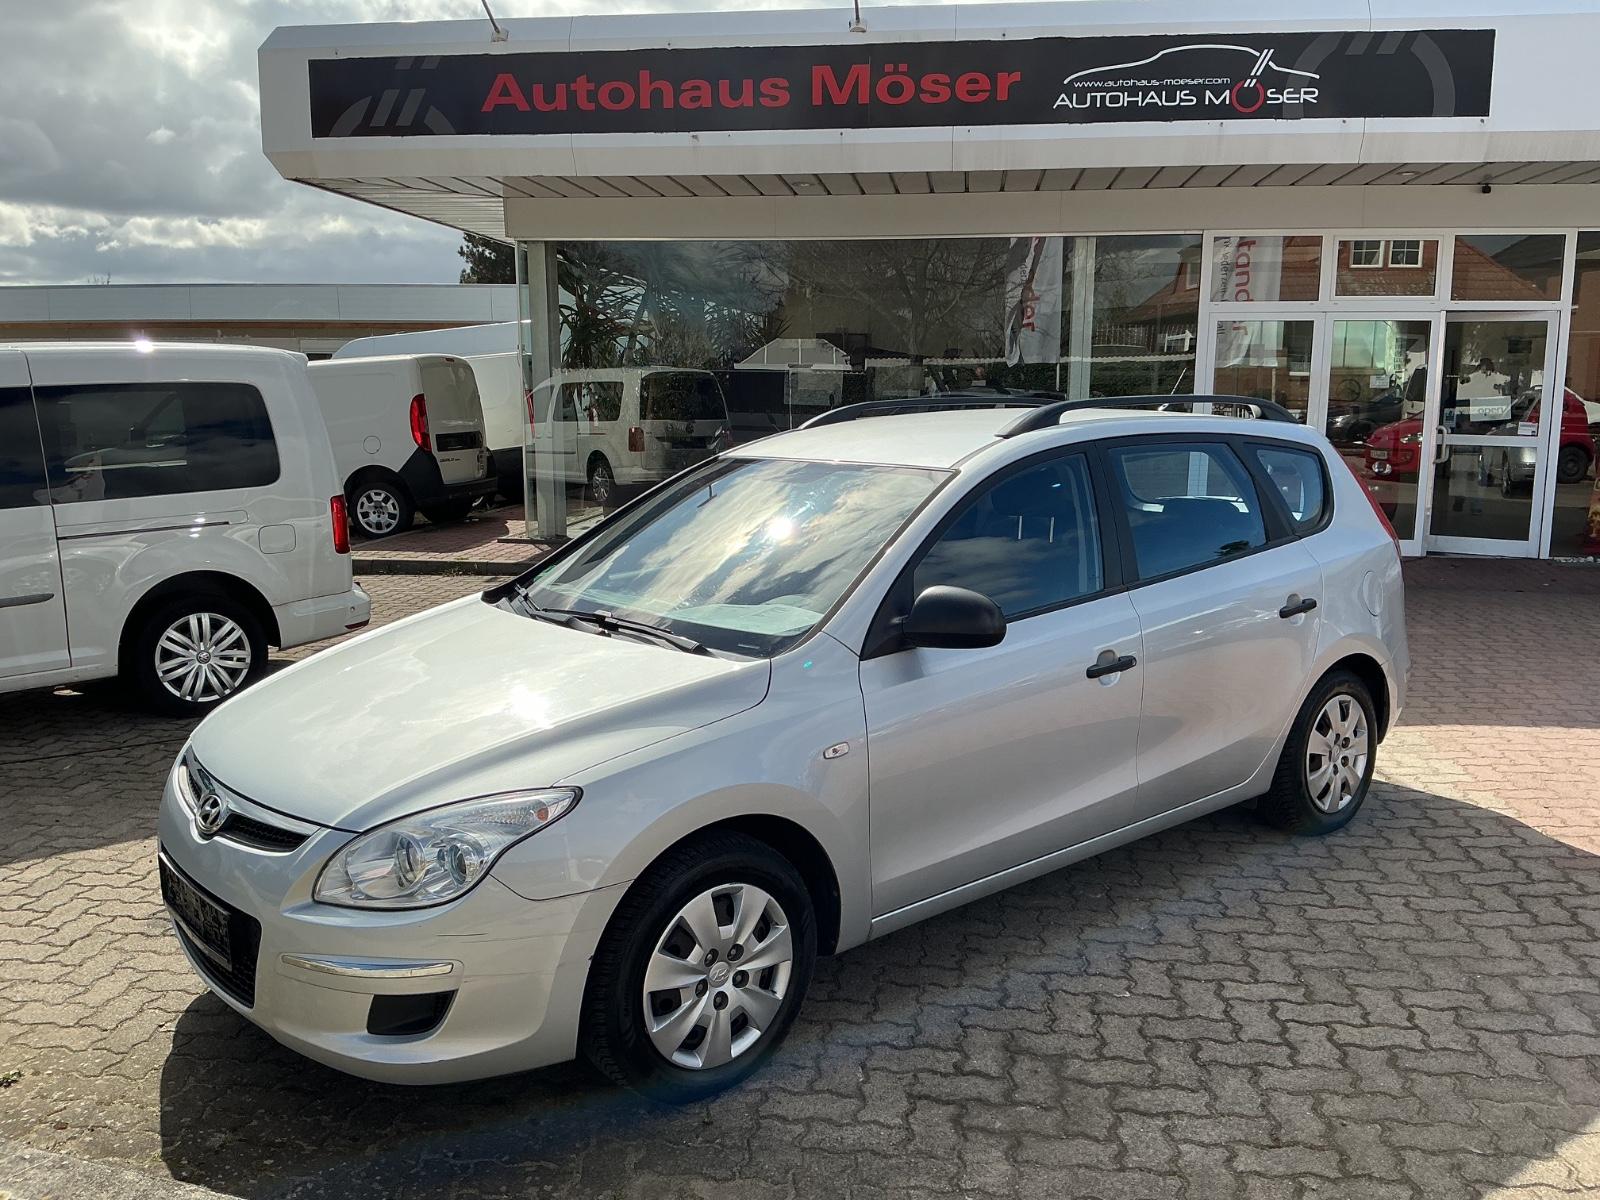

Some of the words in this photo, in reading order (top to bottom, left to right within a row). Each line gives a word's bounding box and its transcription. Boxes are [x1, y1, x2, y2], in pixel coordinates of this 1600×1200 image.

[481, 70, 791, 113] Autohaus
[812, 63, 1022, 107] Möser
[1073, 77, 1231, 88] www.autohaus-moeser.com
[1053, 90, 1197, 109] AUTOHAUS
